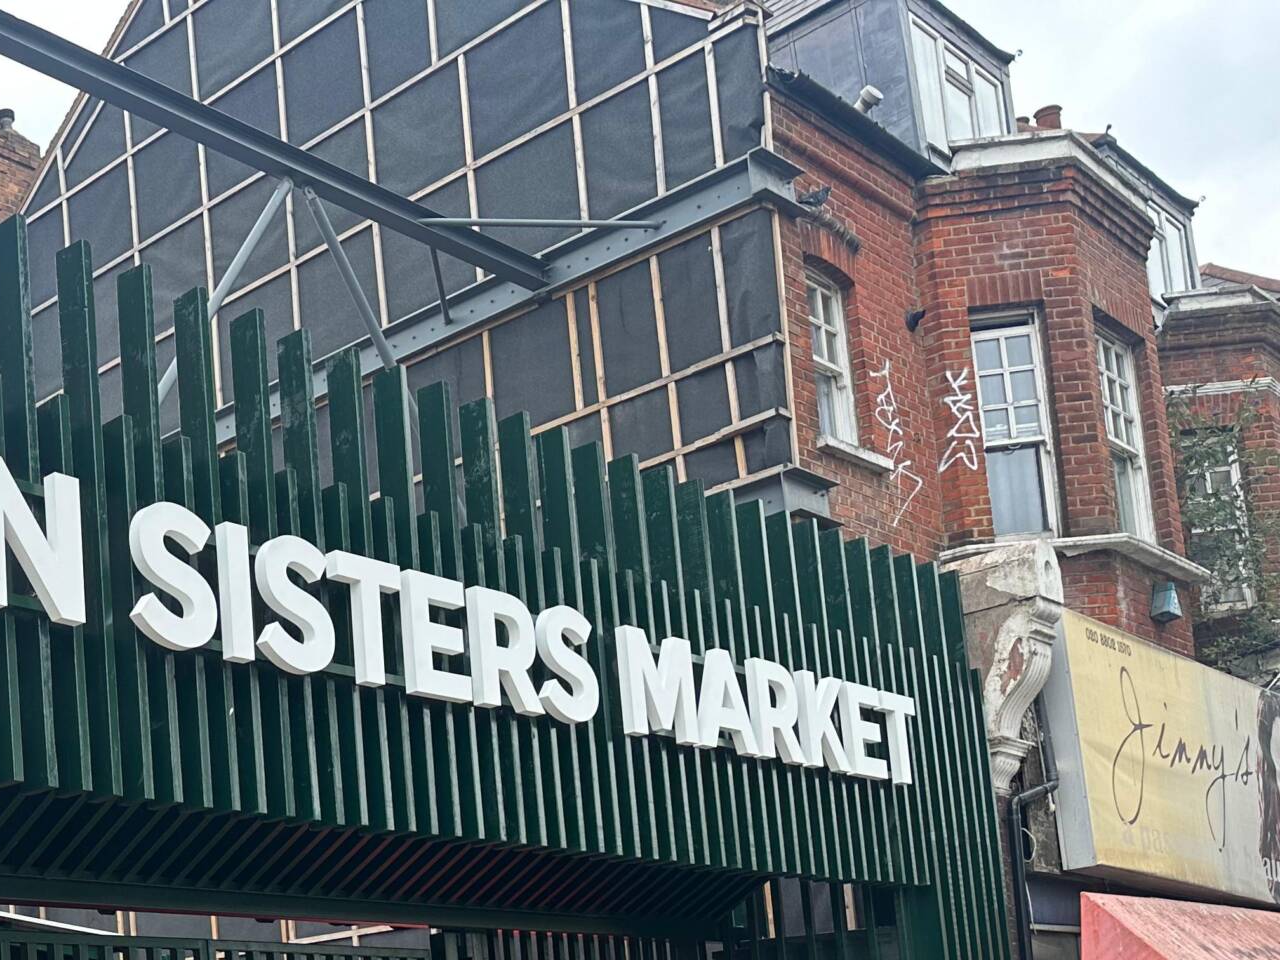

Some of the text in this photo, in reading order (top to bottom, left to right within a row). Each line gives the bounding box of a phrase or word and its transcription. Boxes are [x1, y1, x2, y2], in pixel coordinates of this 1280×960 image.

[129, 501, 600, 725] SISTERS
[614, 624, 917, 786] MARKET
[1085, 627, 1099, 643] 020
[1112, 665, 1253, 853] Jimmy's
